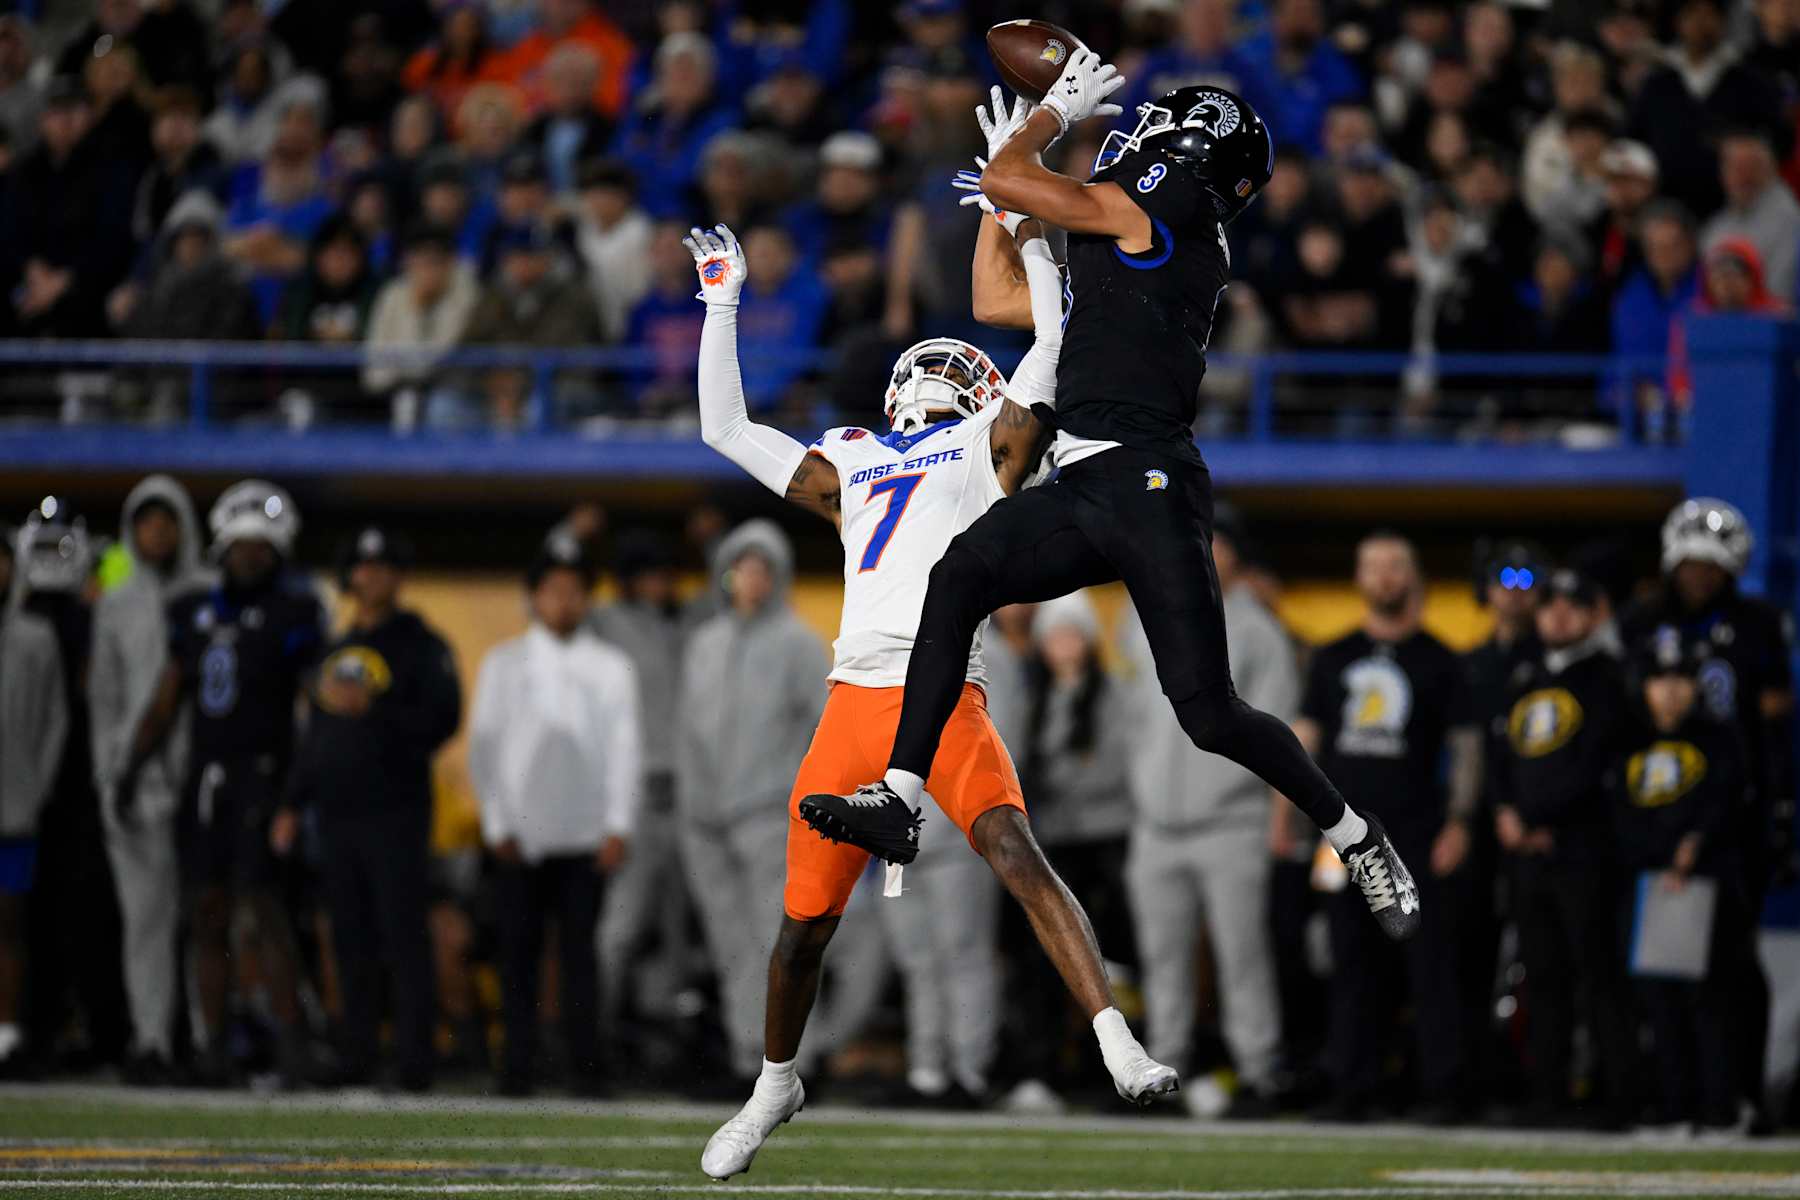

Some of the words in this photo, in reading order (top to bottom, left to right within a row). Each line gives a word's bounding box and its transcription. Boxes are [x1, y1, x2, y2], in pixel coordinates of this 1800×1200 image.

[1138, 163, 1167, 193] 3
[903, 448, 963, 471] STATE
[858, 472, 927, 574] 7
